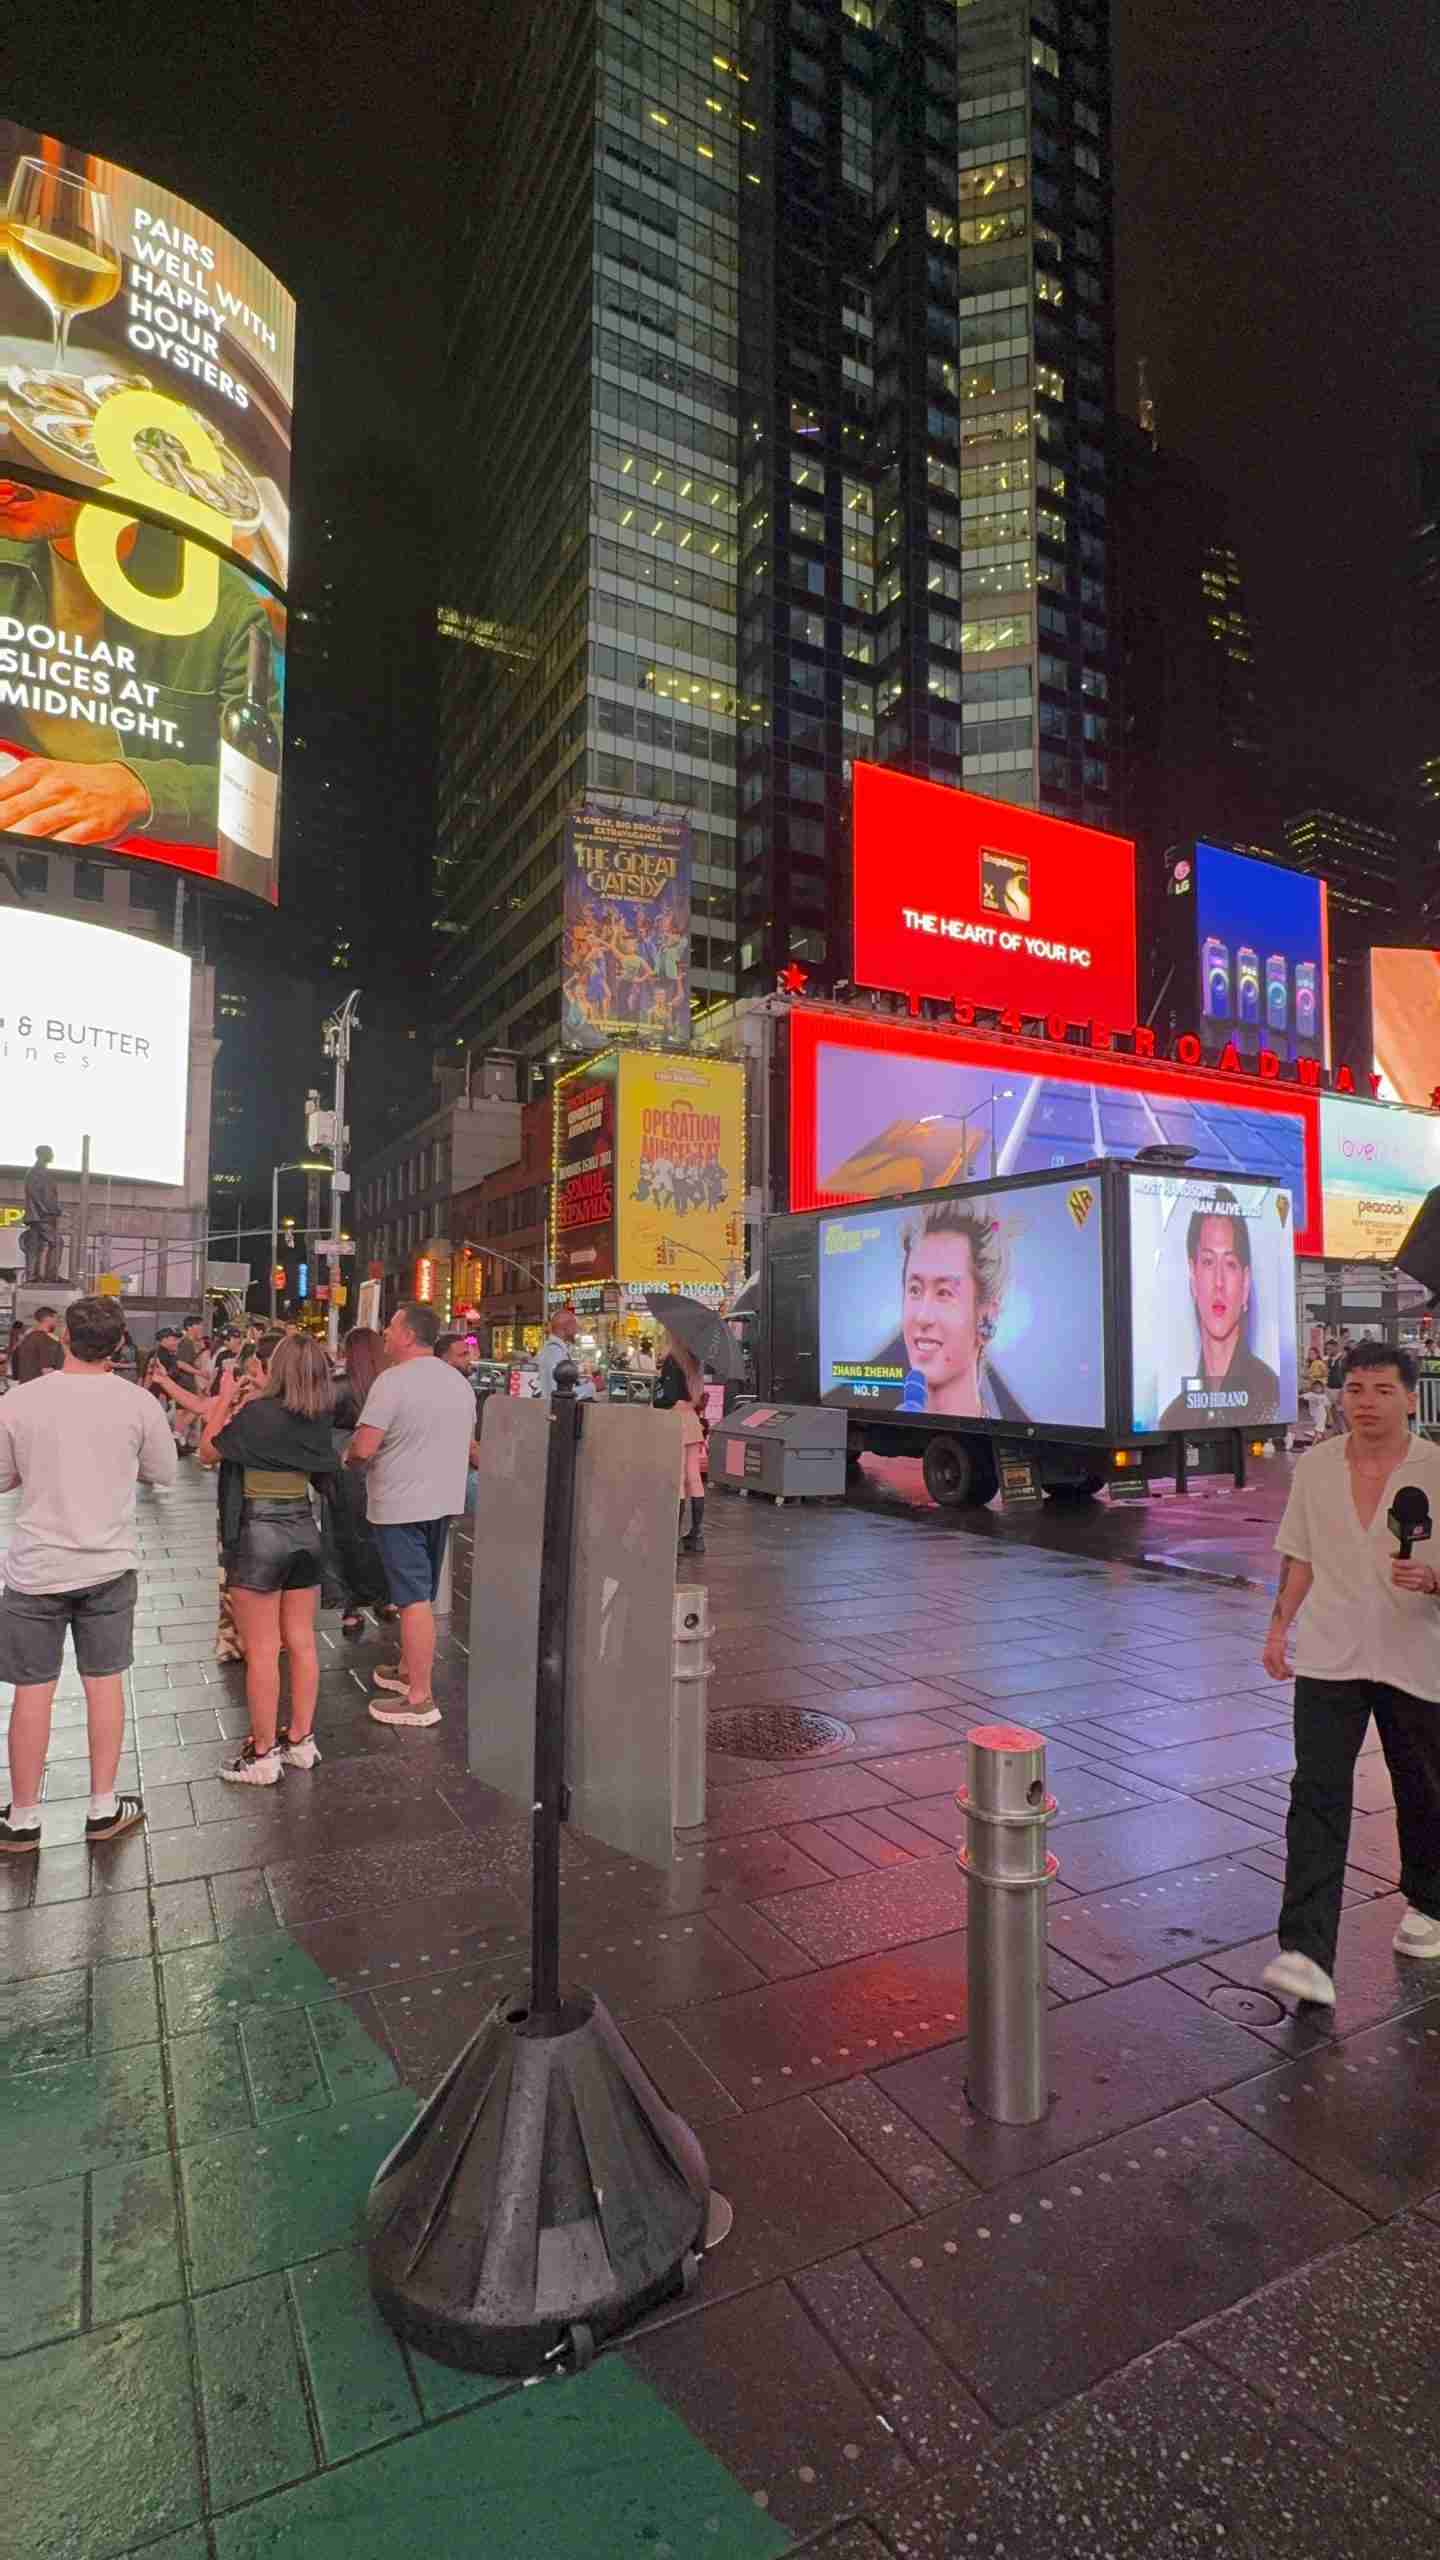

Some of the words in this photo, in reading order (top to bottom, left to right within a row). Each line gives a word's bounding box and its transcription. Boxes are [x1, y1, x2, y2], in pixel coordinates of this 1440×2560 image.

[133, 207, 216, 270] PAIRS
[132, 235, 208, 295] WELL
[216, 281, 277, 352] WITH
[132, 265, 226, 334] HAPPY
[130, 293, 219, 360] HOUR
[128, 325, 249, 409] OYSTERS
[0, 616, 136, 673] DOLLAR
[0, 648, 111, 695] SLICES
[119, 677, 159, 708] AT
[0, 679, 185, 749] MIDNIGHT.
[577, 844, 608, 870] THE
[613, 851, 679, 879] GREAT
[586, 870, 668, 898] GATSBY
[1175, 880, 1190, 895] LG
[902, 908, 937, 934] THE
[940, 917, 997, 947] HEART
[999, 930, 1023, 952] OF
[1024, 937, 1067, 963] YOUR
[1069, 948, 1092, 968] PC
[18, 1016, 32, 1036] &
[46, 1020, 151, 1060] BUTTER
[1090, 1013, 1382, 1101] BROADWAY
[641, 1108, 721, 1141] OPERATION
[1358, 1200, 1406, 1219] peacock
[832, 1365, 863, 1378] ZHANG
[864, 1366, 903, 1379] ZHEHAN
[853, 1384, 871, 1397] NO.
[872, 1385, 880, 1398] 2
[1187, 1392, 1209, 1409] SHO
[1210, 1391, 1249, 1408] HIRANO
